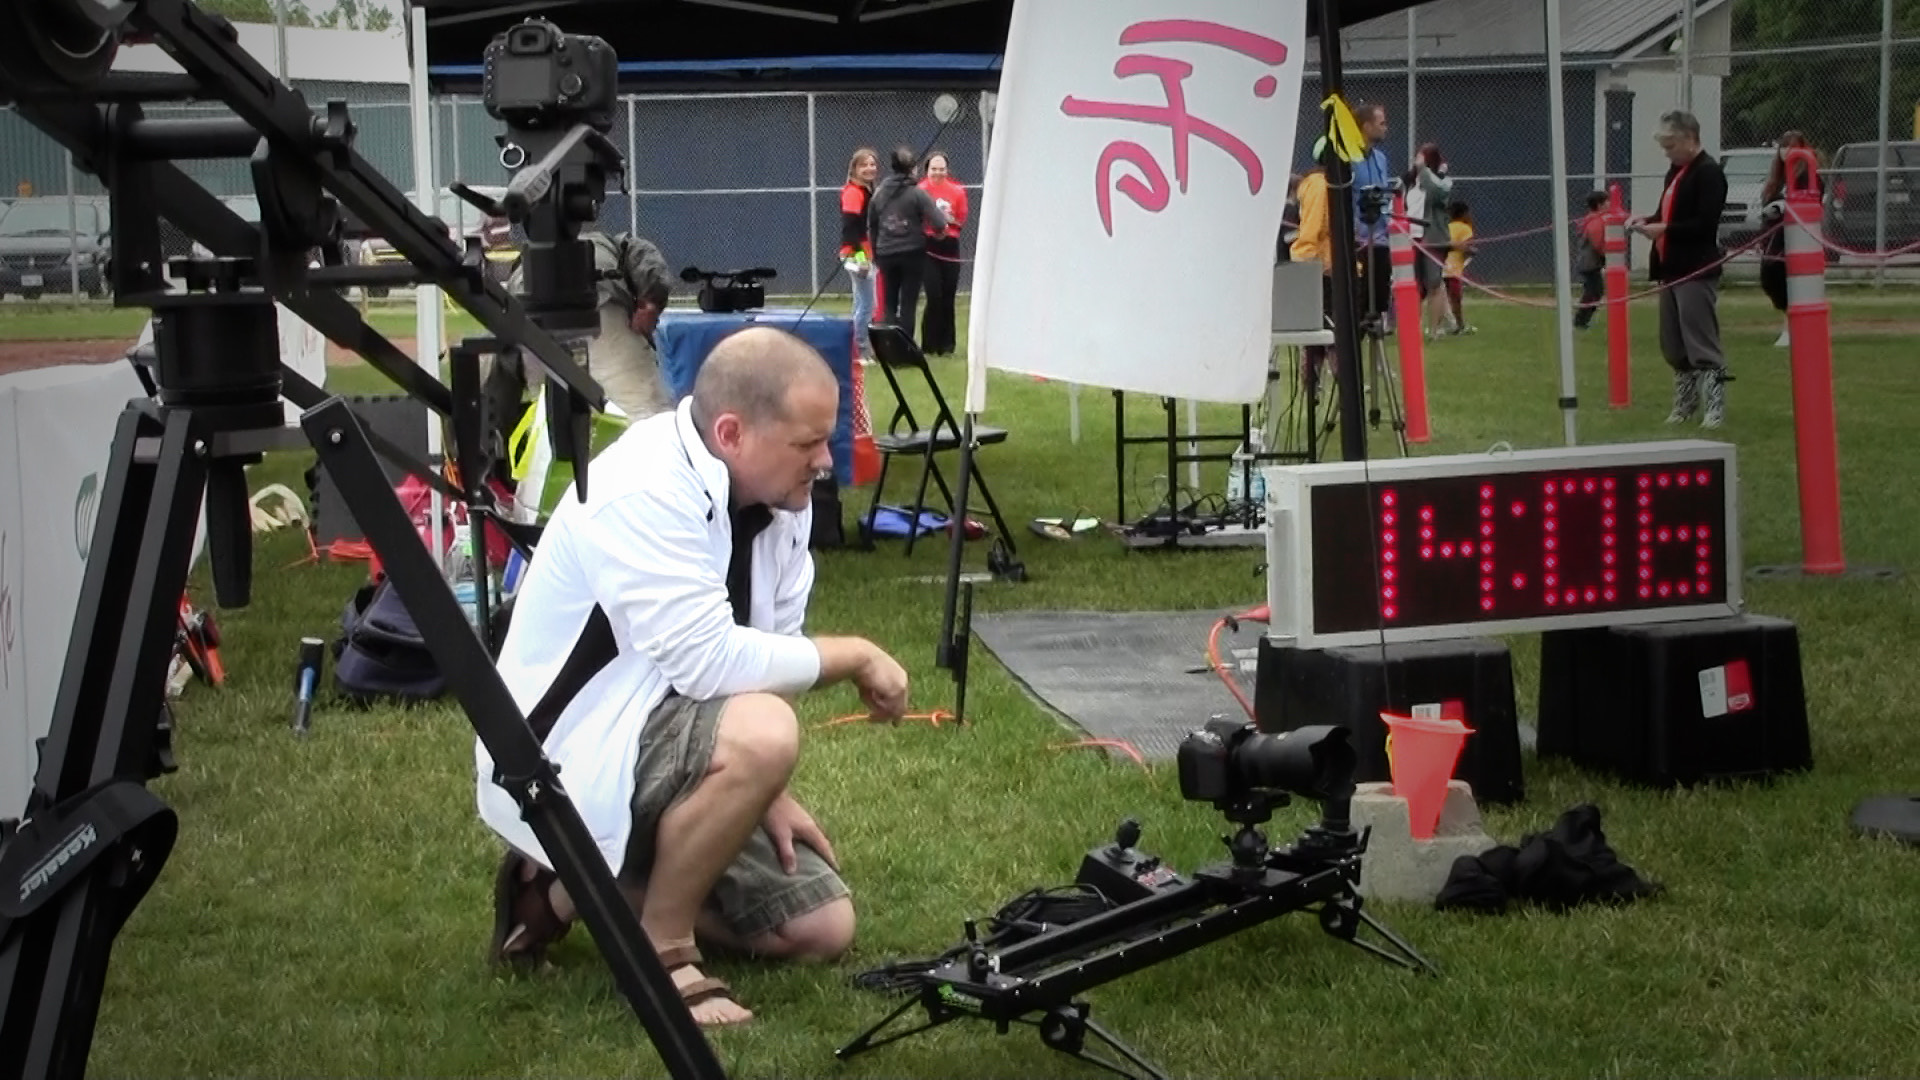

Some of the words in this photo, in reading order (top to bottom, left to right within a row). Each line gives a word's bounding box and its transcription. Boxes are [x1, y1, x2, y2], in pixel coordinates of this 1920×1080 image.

[1060, 20, 1288, 238] life
[1380, 471, 1711, 619] 14:06
[20, 823, 97, 902] Kessler
